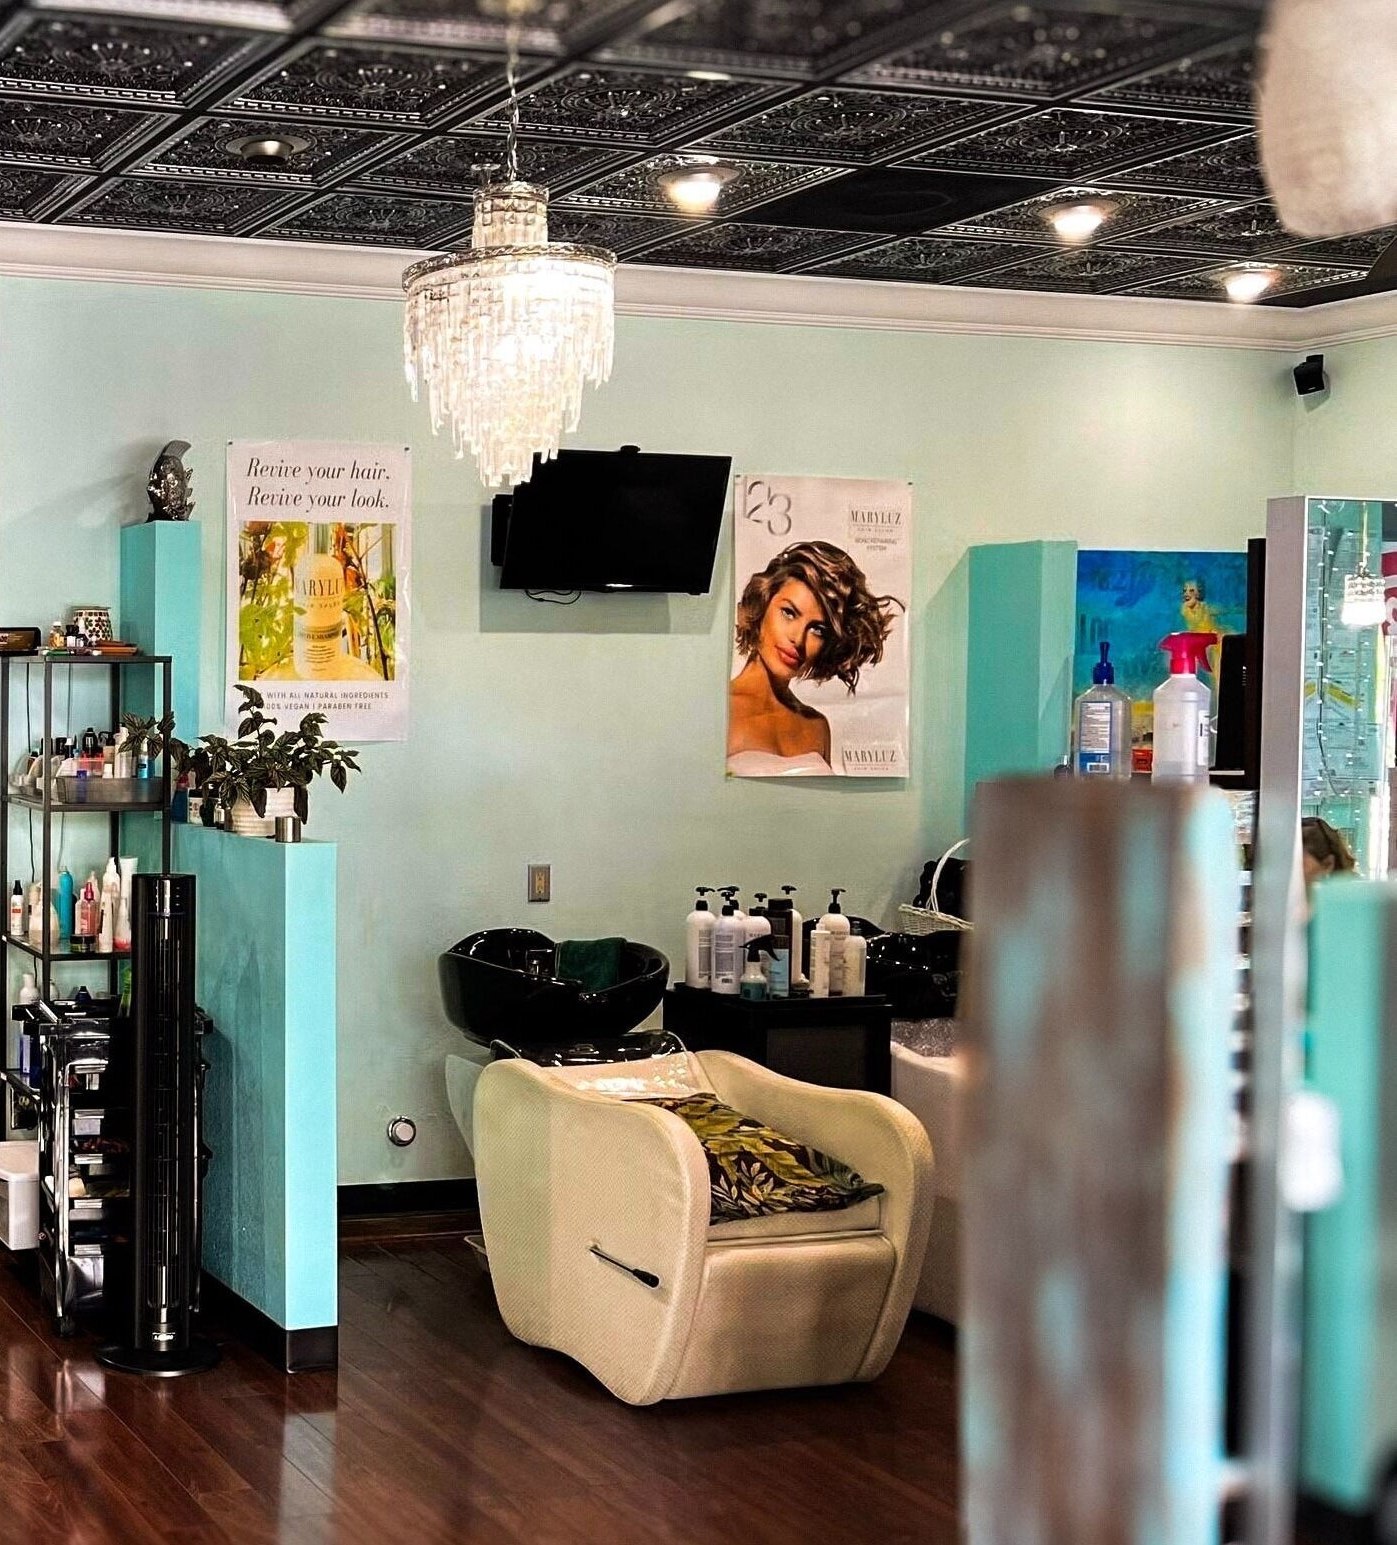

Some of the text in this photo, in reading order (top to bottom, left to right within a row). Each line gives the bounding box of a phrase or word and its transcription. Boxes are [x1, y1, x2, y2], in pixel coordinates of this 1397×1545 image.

[247, 457, 390, 485] Revive your hair.
[247, 486, 389, 513] Revive your look.
[850, 510, 901, 525] MARYLUZ
[844, 750, 896, 762] MARYLUZ
